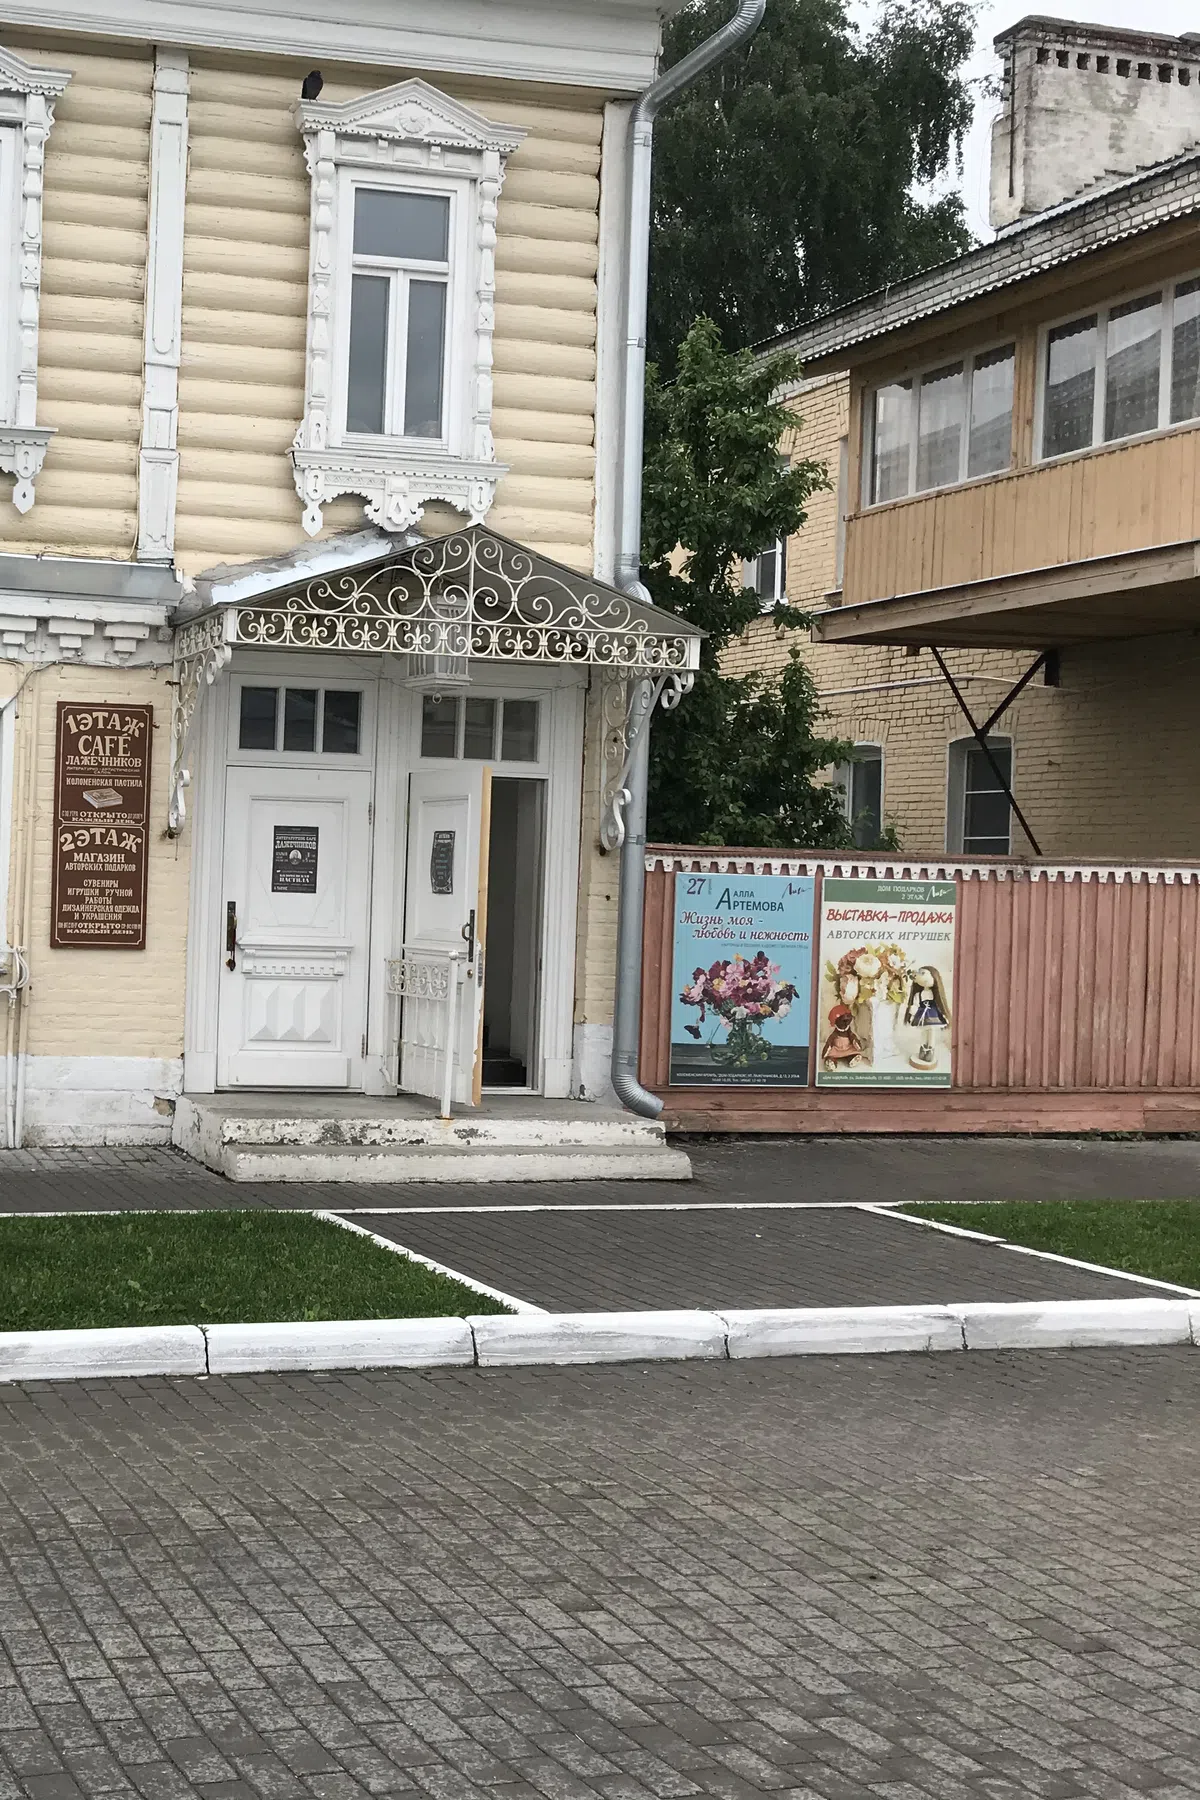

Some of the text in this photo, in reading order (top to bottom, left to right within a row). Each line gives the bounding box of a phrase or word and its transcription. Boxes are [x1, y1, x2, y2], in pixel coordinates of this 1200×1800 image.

[78, 733, 131, 757] CAFÉ
[65, 756, 142, 767] ЛАЖЕЧНИКОВ
[66, 778, 143, 788] КОЛОМЕНСКАЯ ПАСТИЛА
[79, 811, 128, 819] ОТКРЫТО
[73, 852, 125, 863] МАГАЗИН
[64, 862, 136, 872] АВТОРСКИХ ПОДАРКОВ
[83, 879, 119, 888] СУВЕНИРЫ
[687, 878, 706, 895] 27
[67, 887, 133, 897] ИГРУШКИ РУЧНОЙ
[85, 896, 112, 905] РАБОТЫ
[62, 904, 140, 913] ДИЗАЙНЕРСКАЯ ОДЕЖДА
[74, 912, 122, 920] И УКРАШЕНИЯ
[680, 912, 724, 929] Жизнь
[727, 917, 754, 925] моя
[692, 928, 809, 942] любовь и нежность
[827, 930, 952, 941] АВТОРСКИХ ИГРУШЕК
